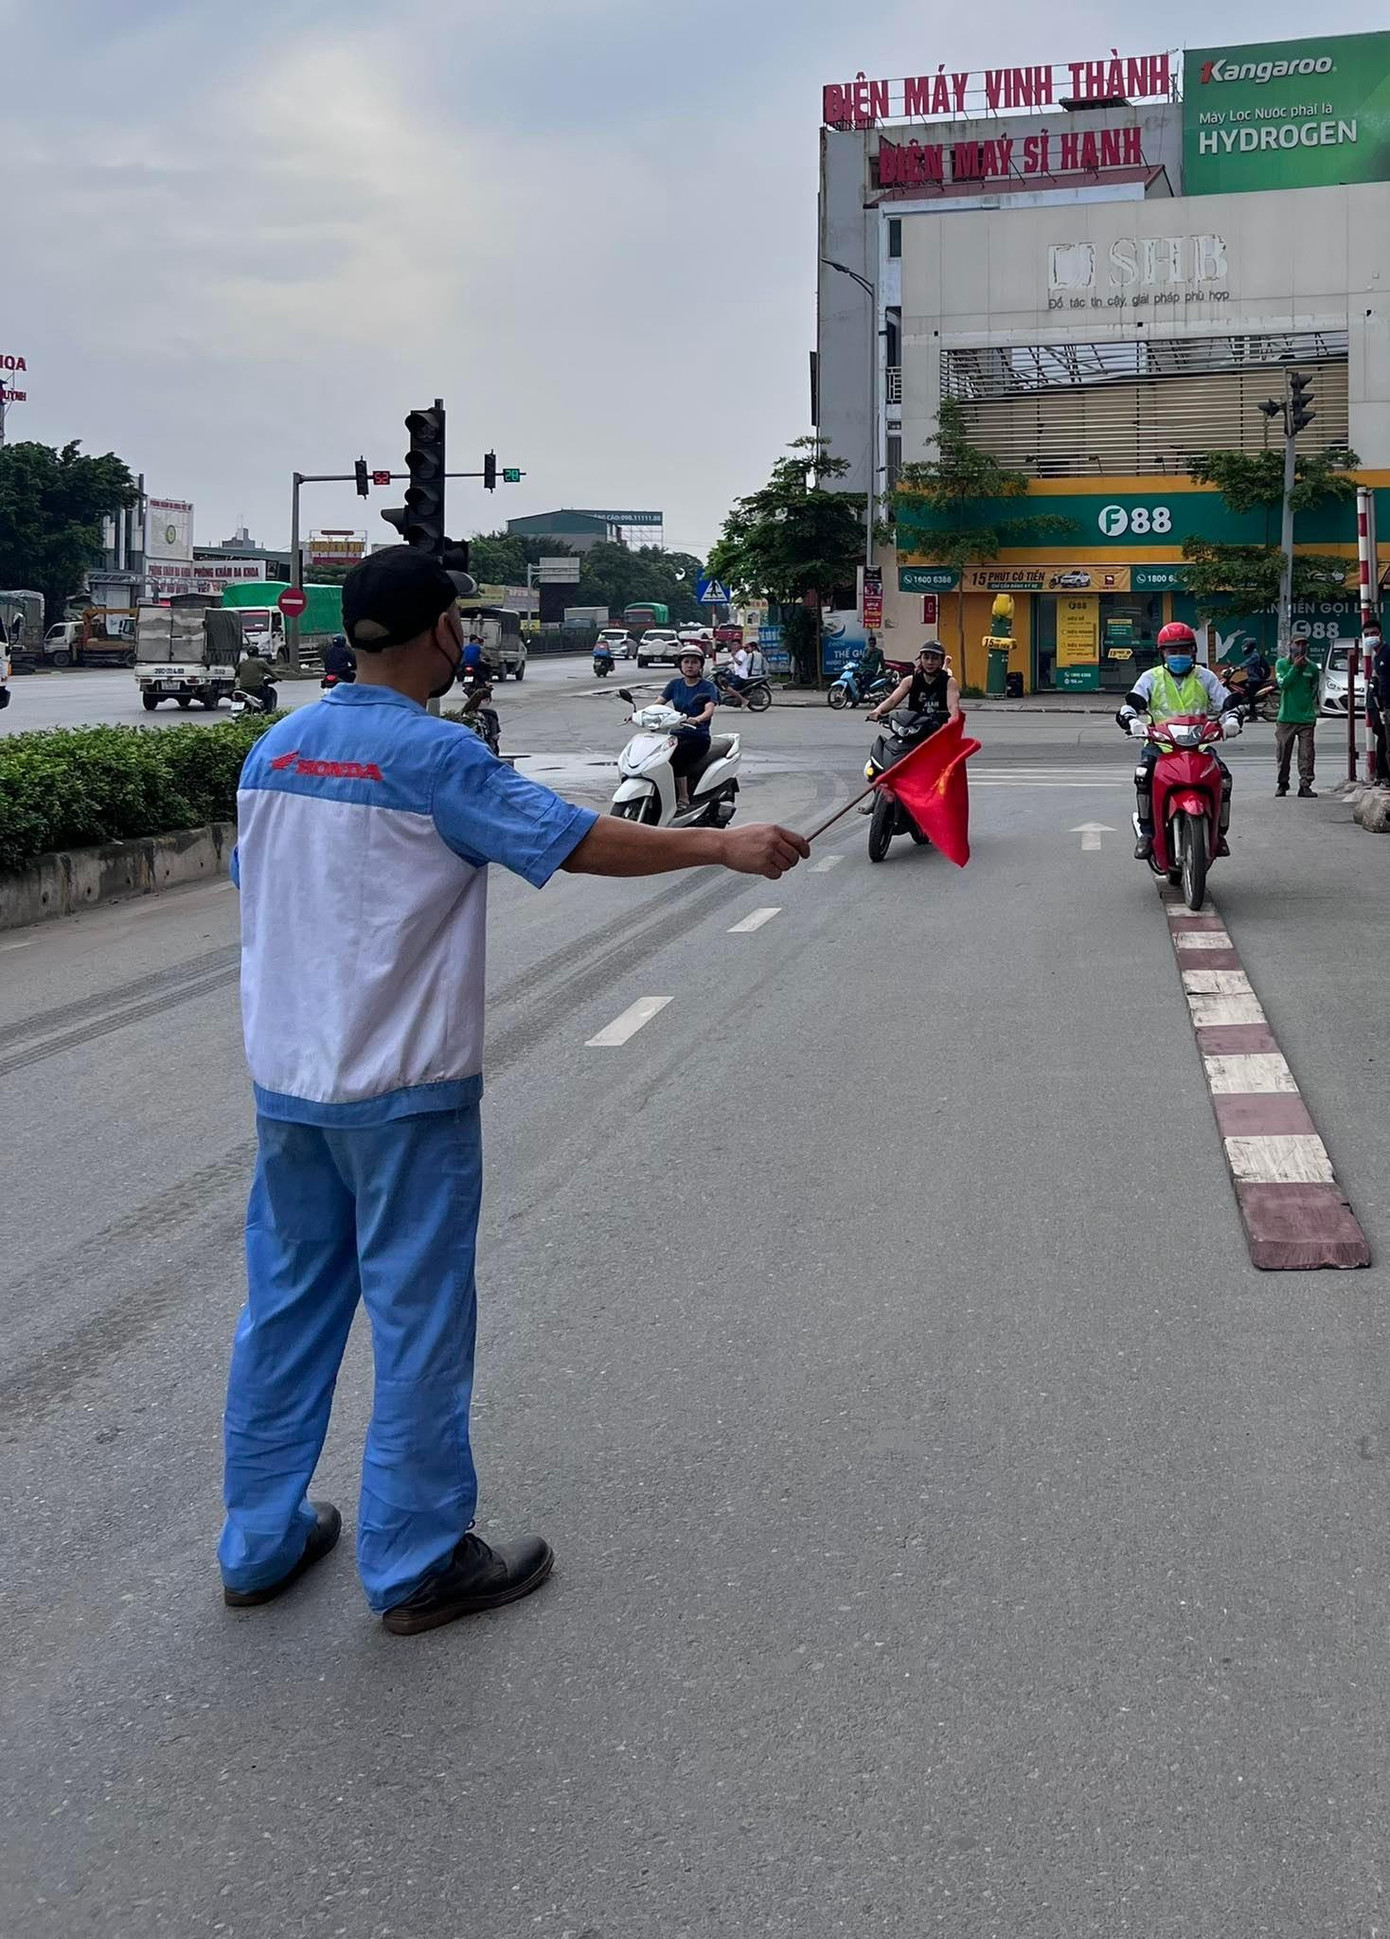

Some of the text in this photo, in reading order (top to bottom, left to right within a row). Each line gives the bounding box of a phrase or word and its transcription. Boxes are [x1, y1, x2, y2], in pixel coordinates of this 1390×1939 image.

[905, 64, 969, 116] MÁY
[985, 66, 1052, 110] VINH
[1067, 49, 1170, 101] THÀNH
[1229, 109, 1251, 125] Lọc
[1200, 120, 1357, 154] HYDROGEN
[1110, 234, 1228, 288] SHB
[505, 470, 519, 481] 28
[1098, 504, 1172, 537] F88
[972, 572, 987, 586] 15
[1147, 574, 1167, 583] 1800
[1320, 602, 1349, 616] GỌI
